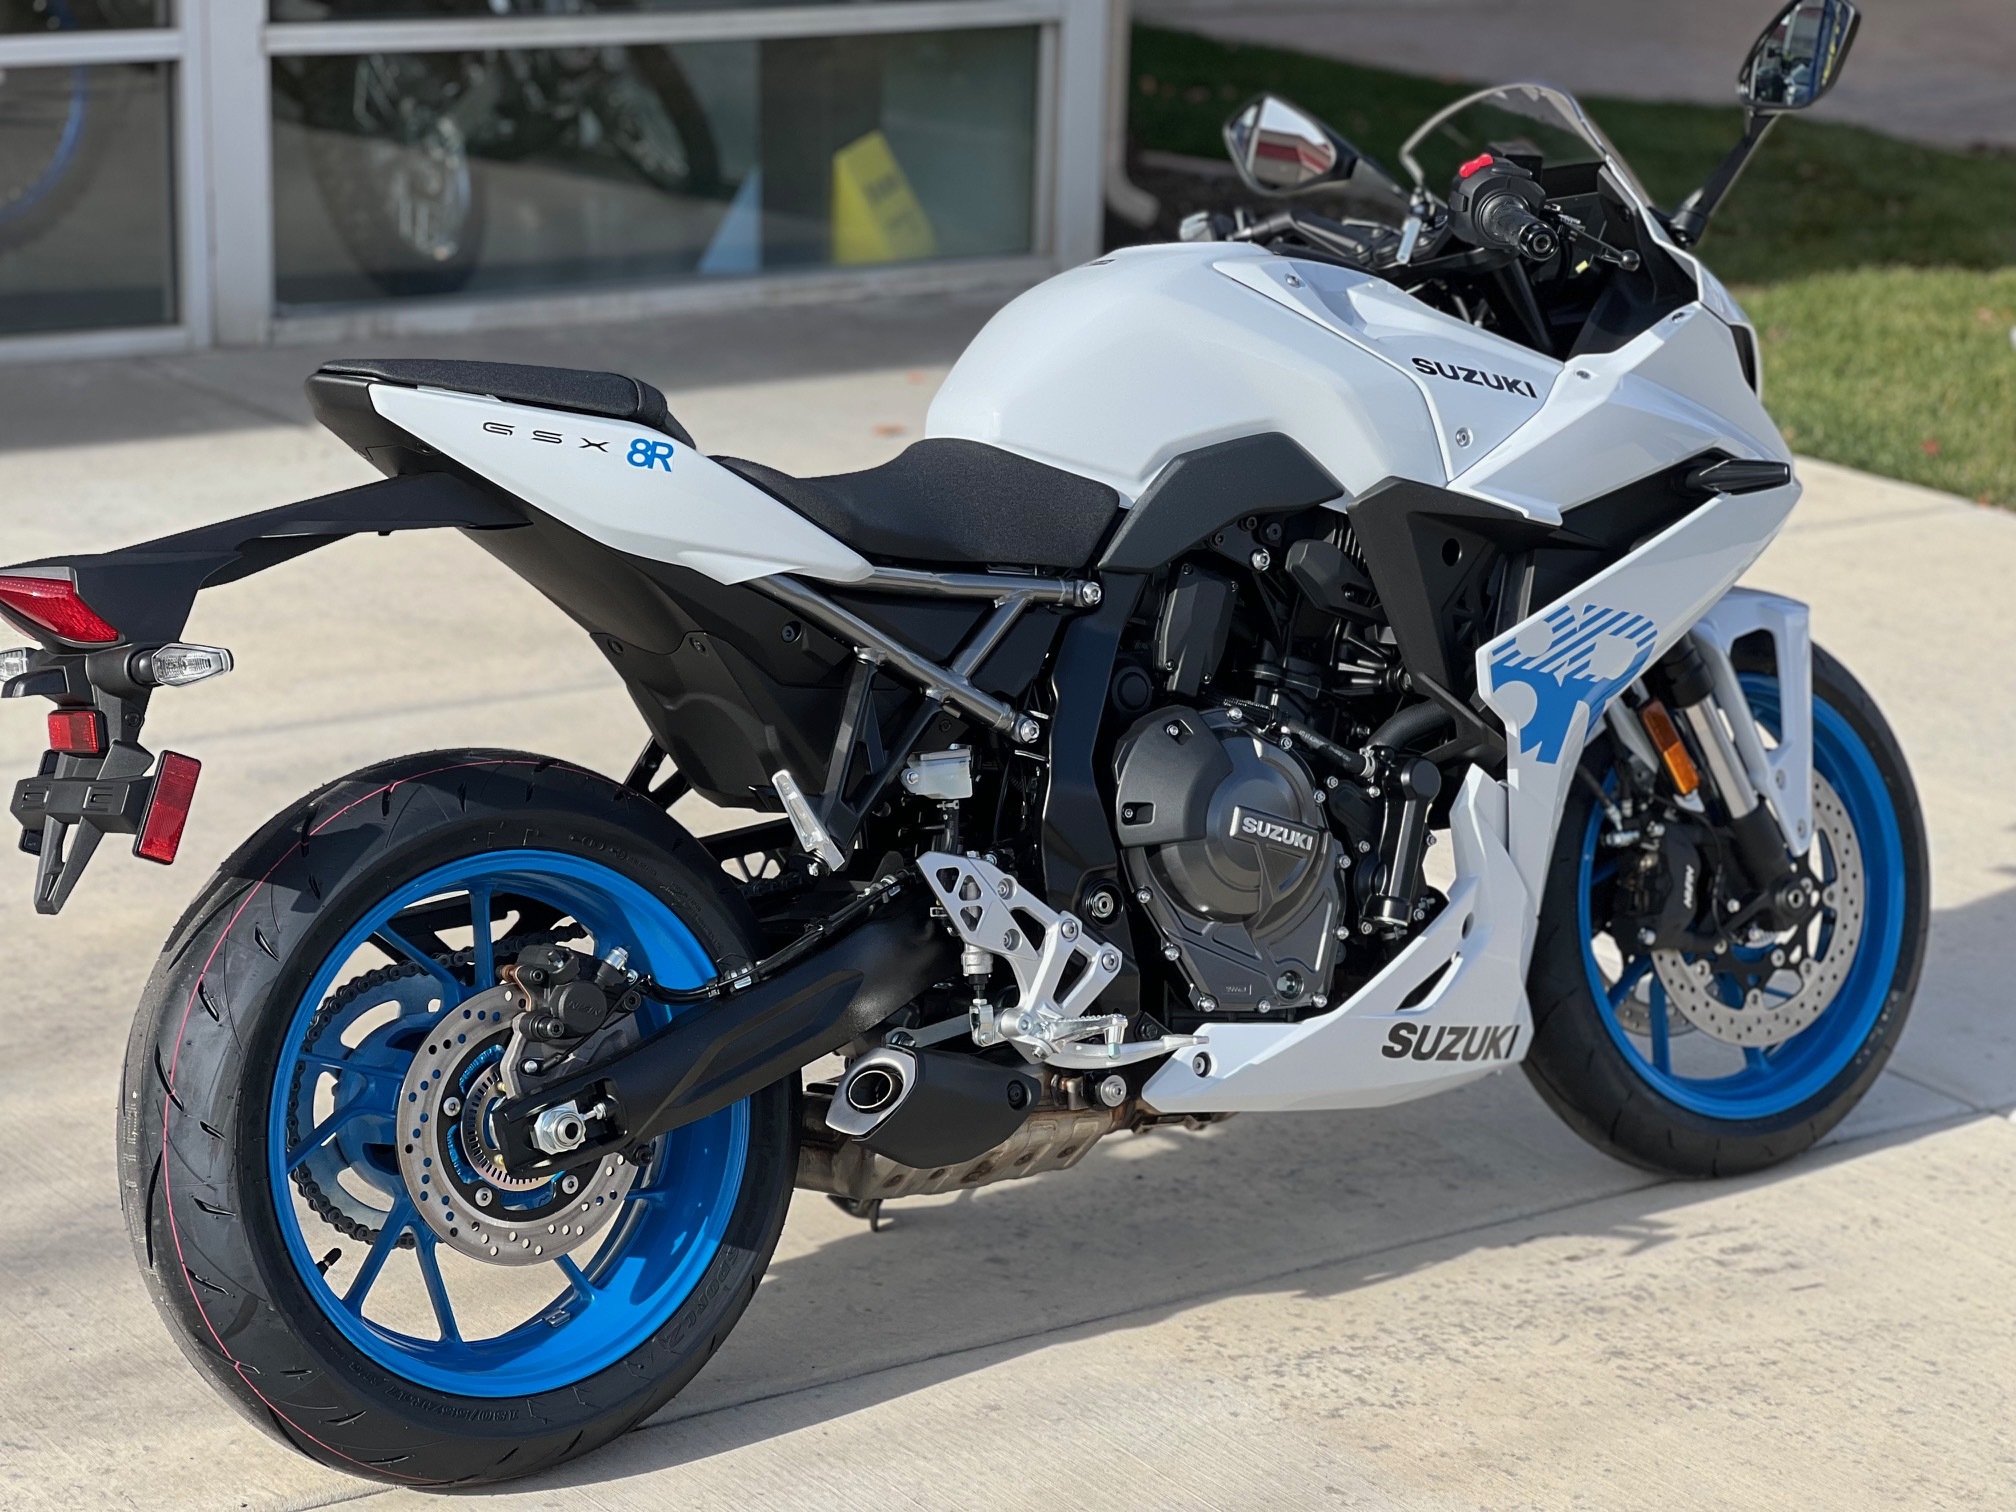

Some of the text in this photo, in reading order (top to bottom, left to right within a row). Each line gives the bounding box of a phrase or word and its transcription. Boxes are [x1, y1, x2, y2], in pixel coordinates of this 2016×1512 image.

[1411, 357, 1537, 399] SUZUKI
[626, 438, 674, 472] 8R
[1242, 817, 1313, 850] SUZUKI
[1381, 1022, 1520, 1061] SUZUKI
